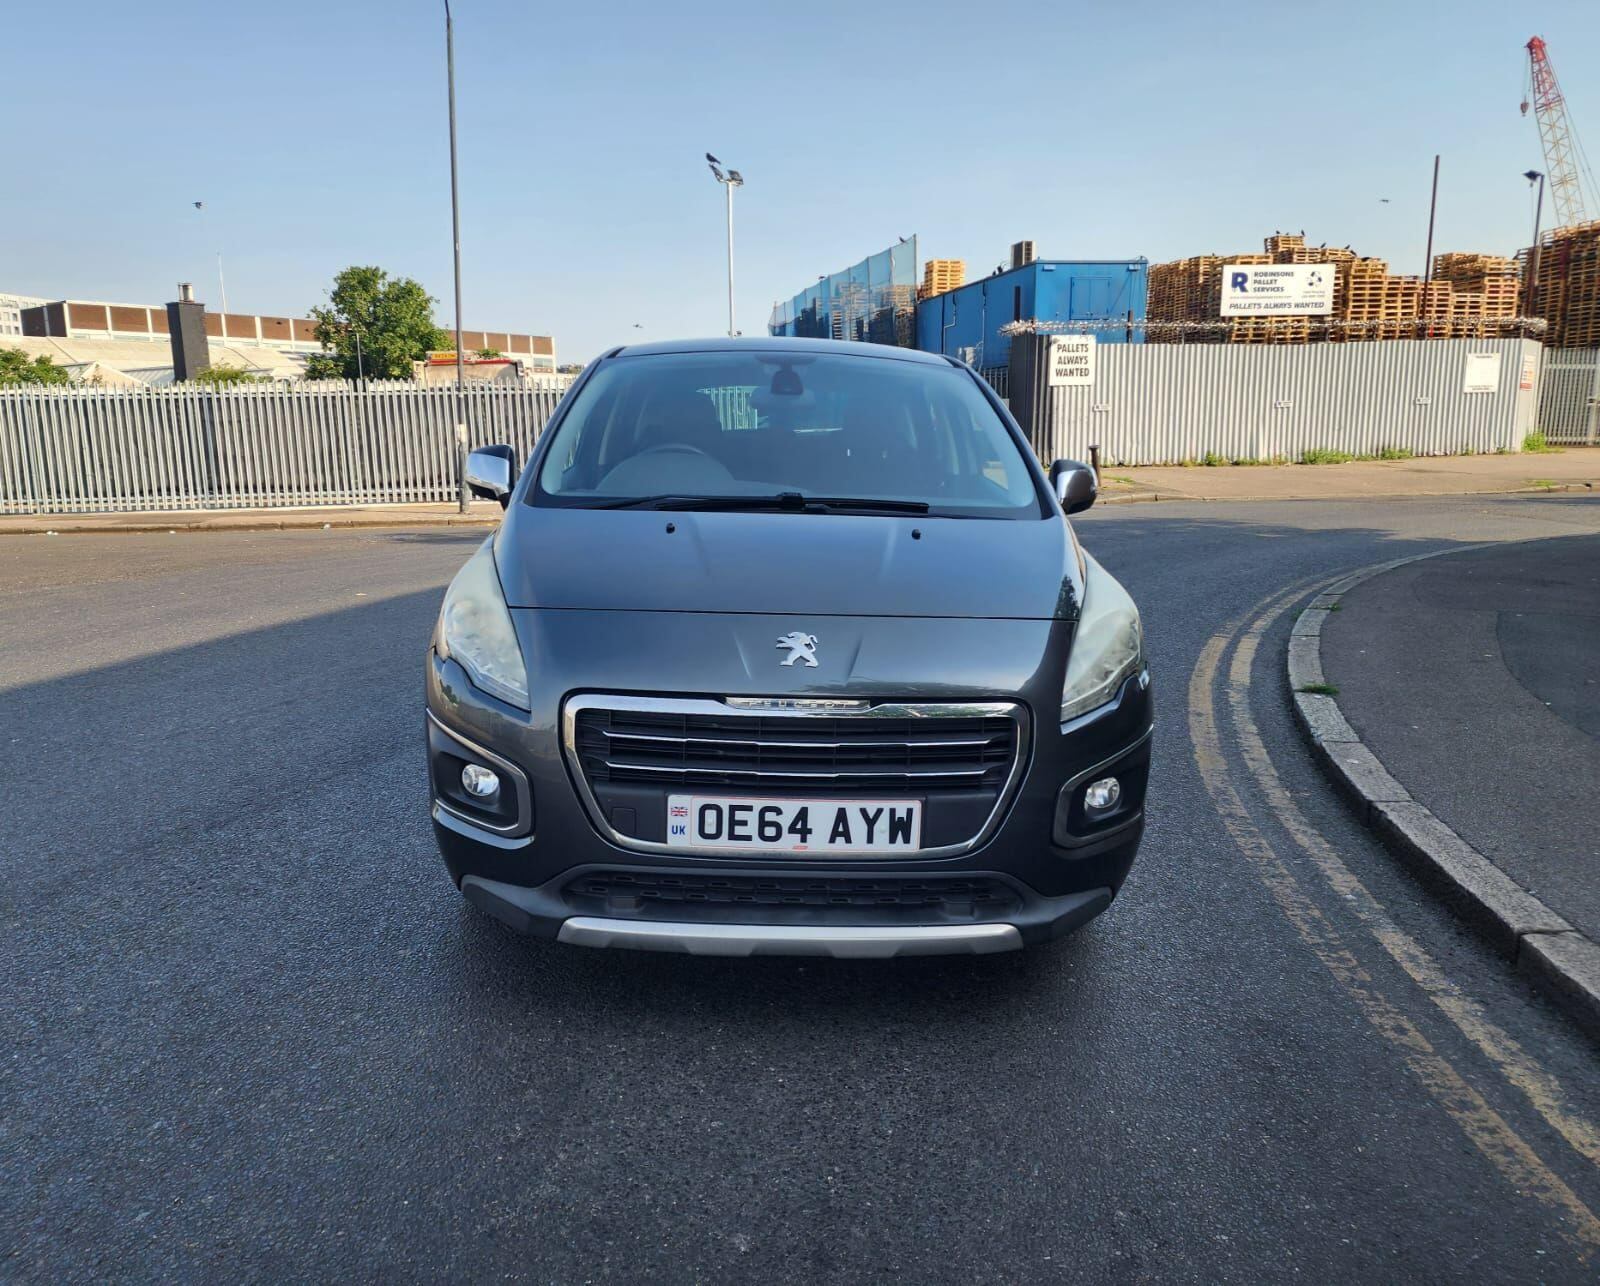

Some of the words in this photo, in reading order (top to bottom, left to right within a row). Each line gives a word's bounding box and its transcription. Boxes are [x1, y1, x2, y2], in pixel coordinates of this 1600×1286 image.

[1231, 272, 1248, 292] R
[1294, 301, 1325, 309] WANTED
[1056, 343, 1089, 353] PALLETS
[1057, 355, 1088, 365] ALWAYS
[1055, 368, 1090, 377] WANTED
[697, 803, 813, 844] OE64
[828, 807, 914, 844] AYW
[671, 824, 686, 835] UK
